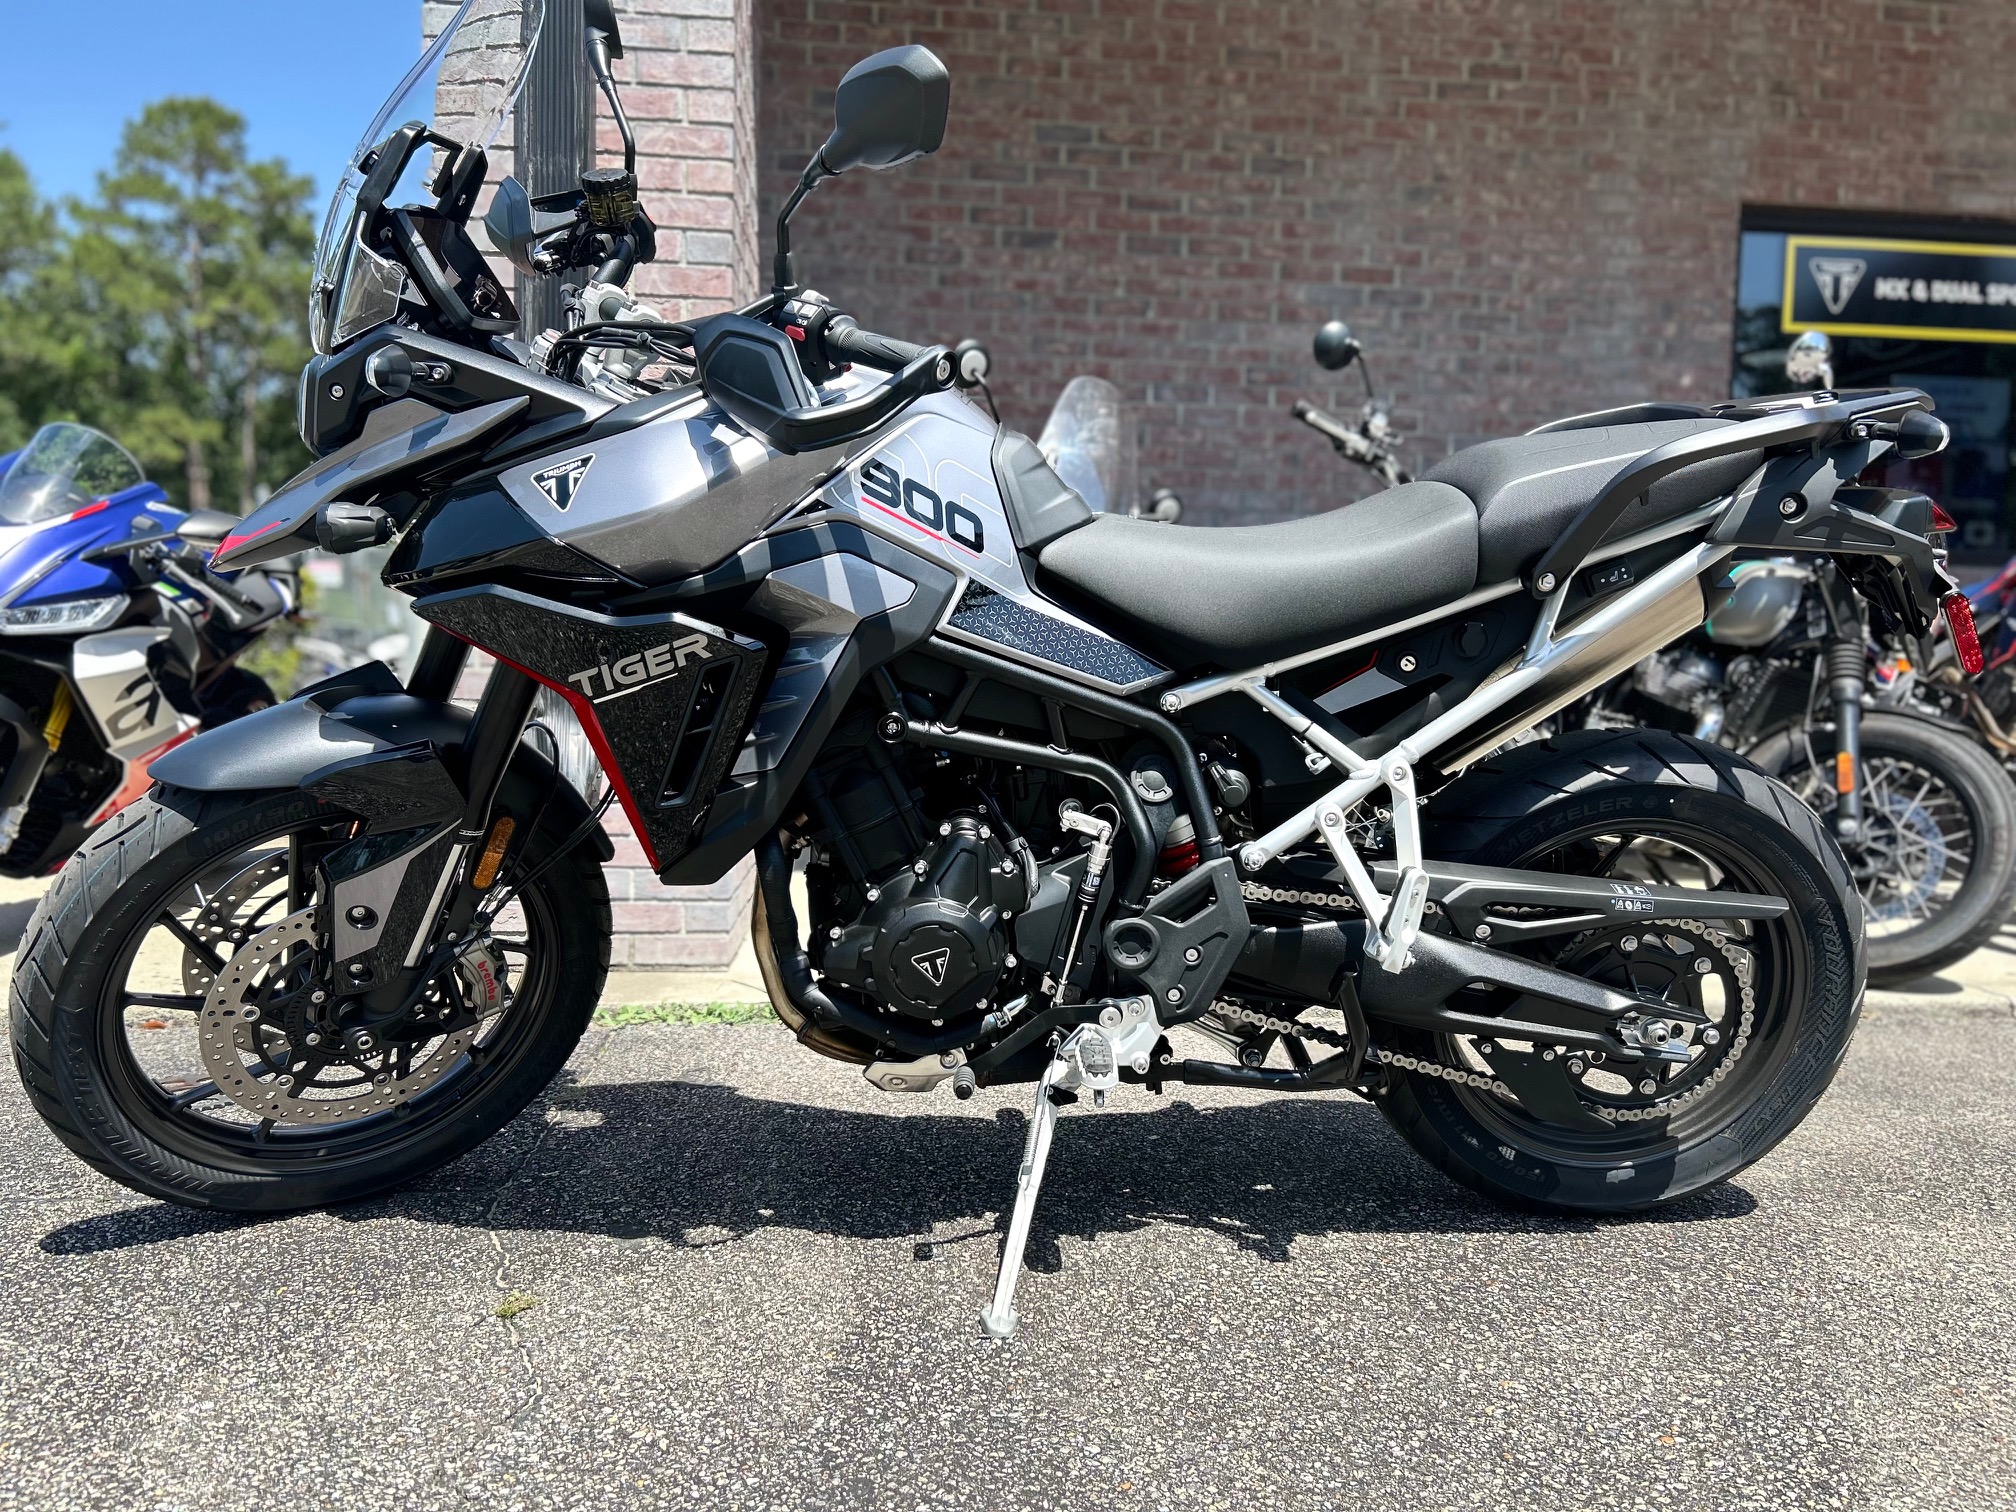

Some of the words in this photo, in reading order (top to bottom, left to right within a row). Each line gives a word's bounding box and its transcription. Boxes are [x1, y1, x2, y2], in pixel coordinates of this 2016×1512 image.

[1911, 278, 1929, 303] &
[1930, 279, 1984, 305] DUAL
[543, 460, 582, 478] TRIUMPH
[860, 457, 985, 553] 900
[568, 633, 713, 697] TIGER
[203, 800, 305, 848] 100/90
[1496, 797, 1633, 857] METZELER
[477, 960, 497, 1001] brembo
[1803, 914, 1843, 1081] TOURANCE
[78, 1103, 243, 1204] TOURANCE
